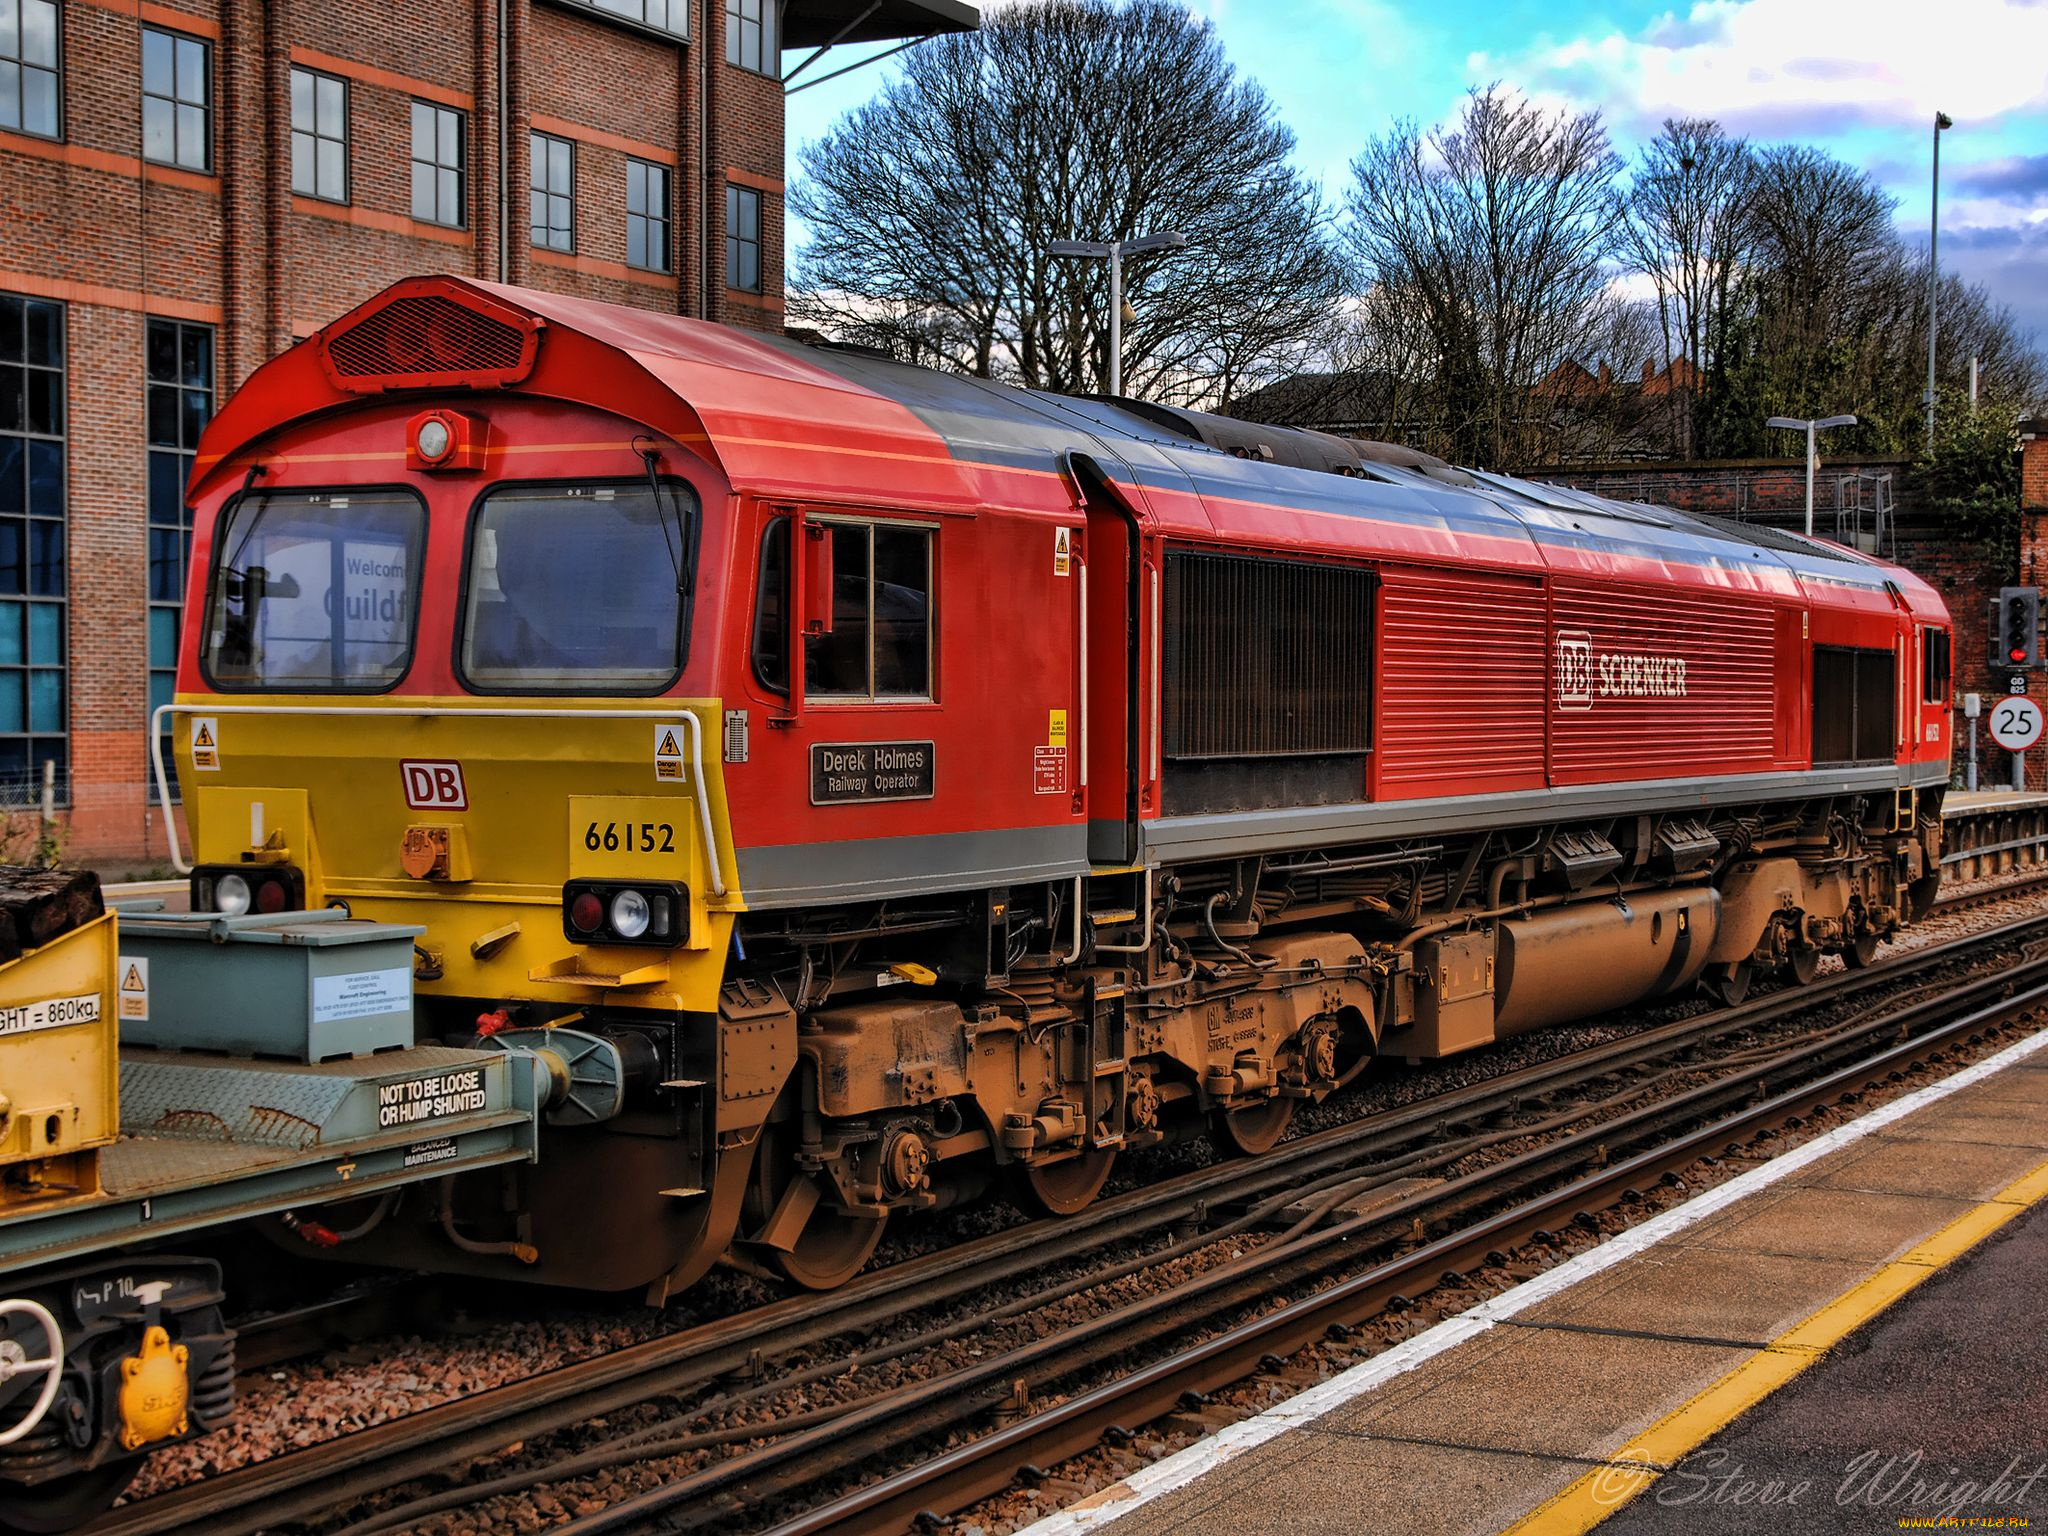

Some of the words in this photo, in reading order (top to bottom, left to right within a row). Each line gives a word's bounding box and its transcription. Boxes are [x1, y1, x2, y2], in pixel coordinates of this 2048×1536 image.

[346, 557, 406, 578] Welcom
[1599, 654, 1687, 696] SCHENKER
[2000, 709, 2032, 735] 25
[823, 750, 866, 772] Derek
[874, 749, 924, 770] Holmes
[408, 767, 460, 803] DB
[828, 776, 867, 793] Railway
[874, 773, 919, 792] Operator
[585, 822, 675, 853] 66152
[380, 1084, 405, 1105] NOT
[406, 1081, 423, 1100] TO
[424, 1078, 440, 1098] BE
[441, 1071, 479, 1095] LOOSE
[380, 1106, 399, 1126] OR
[399, 1099, 433, 1122] HUMP
[433, 1090, 486, 1116] SHUNTED
[404, 1146, 457, 1166] MAINTENANCE
[142, 1199, 151, 1219] 1
